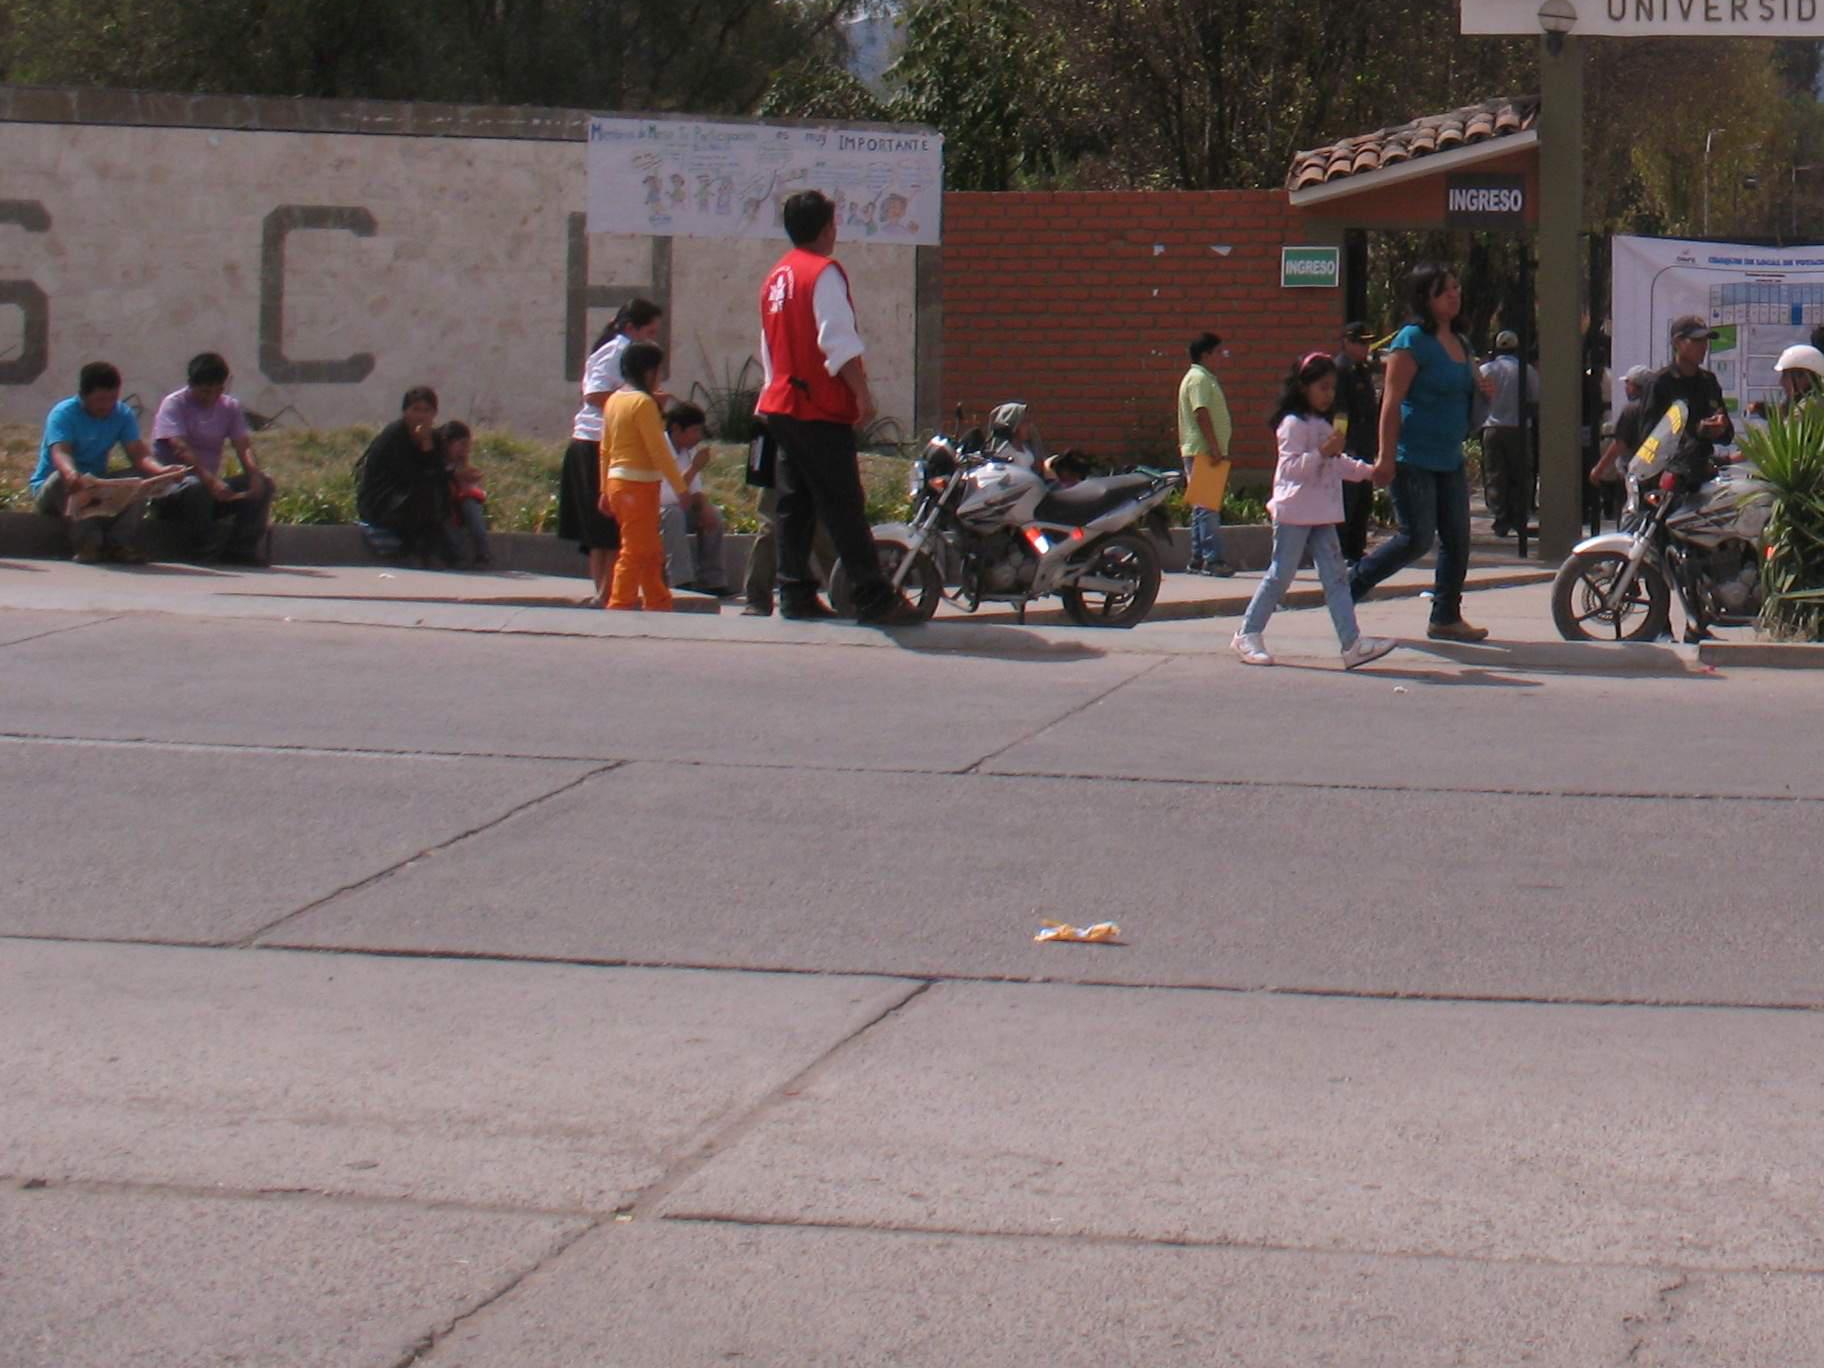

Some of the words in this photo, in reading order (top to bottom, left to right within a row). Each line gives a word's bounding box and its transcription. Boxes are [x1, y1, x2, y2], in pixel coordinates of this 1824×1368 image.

[838, 134, 929, 152] IMPORTANTE
[1449, 188, 1522, 212] INGRESO
[1284, 259, 1336, 275] INGRESO
